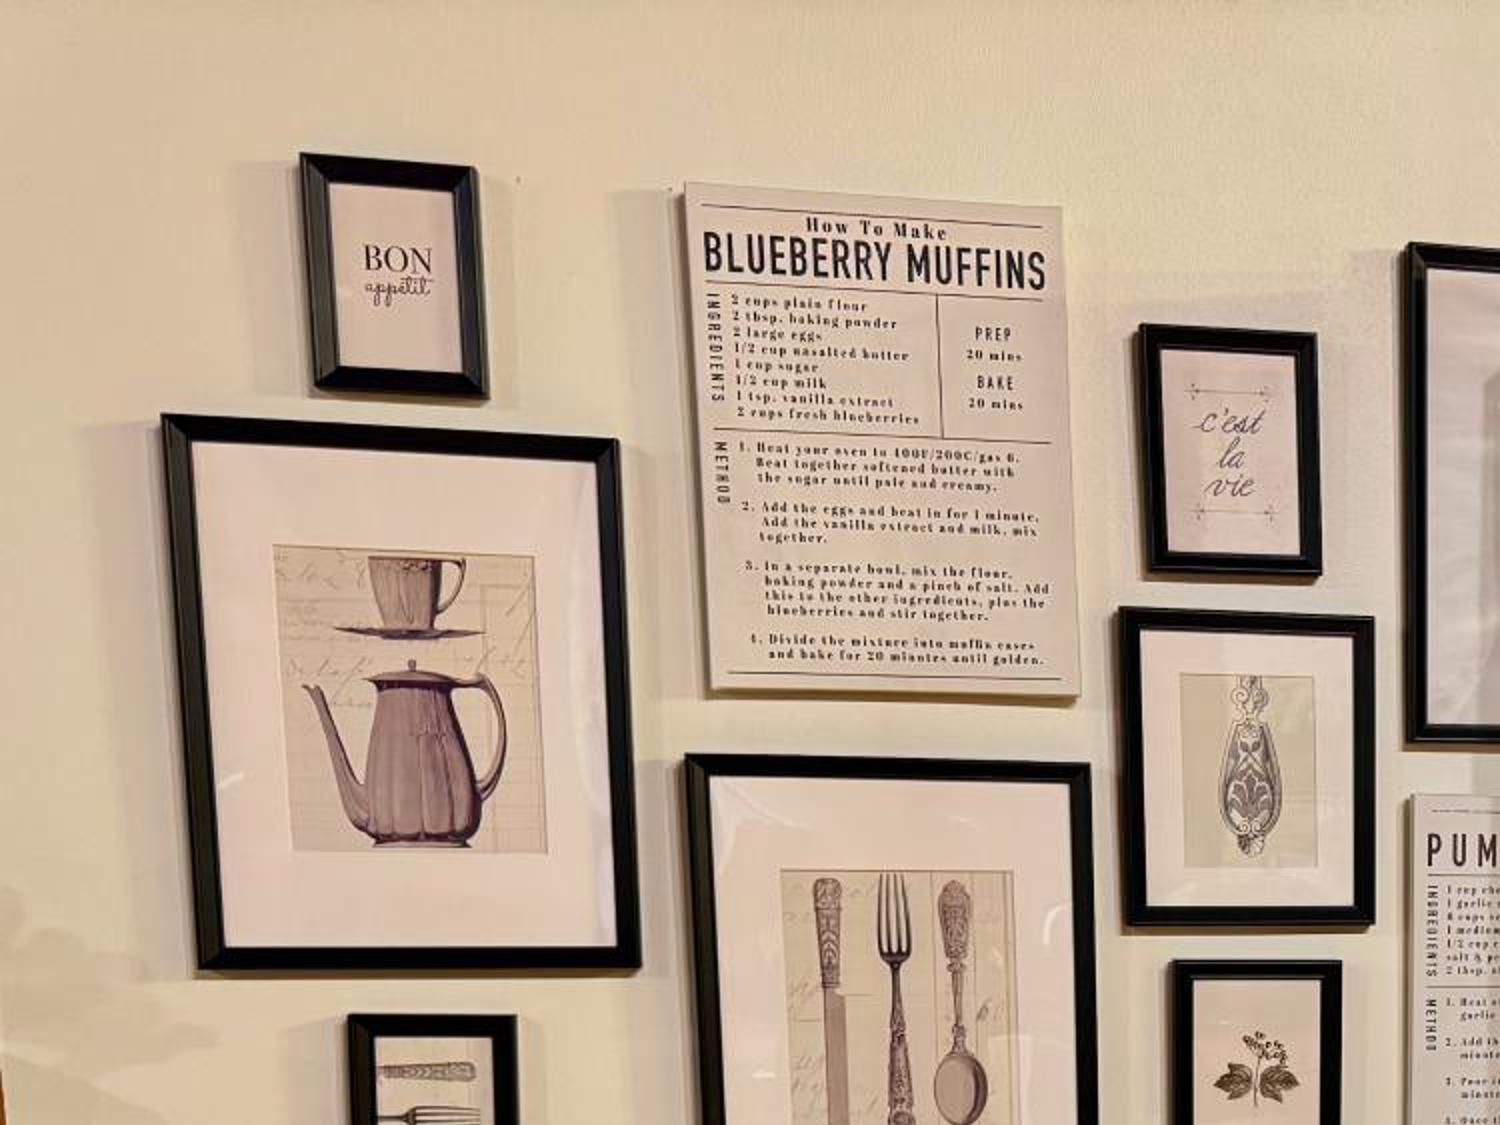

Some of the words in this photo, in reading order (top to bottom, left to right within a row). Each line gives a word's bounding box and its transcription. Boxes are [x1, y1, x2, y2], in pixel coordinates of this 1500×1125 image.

[806, 216, 848, 235] How
[859, 219, 883, 236] To
[894, 221, 947, 241] Make
[363, 243, 432, 274] BON
[704, 231, 891, 282] BLUEBERRY
[907, 243, 1045, 291] MUFFINS
[745, 296, 777, 311] cups
[784, 295, 821, 313] plain
[828, 297, 865, 312] flour
[745, 308, 782, 327] tbsp.
[789, 311, 838, 330] baking
[844, 314, 896, 333] powder
[746, 324, 784, 344] large
[791, 331, 821, 346] eggs
[974, 326, 1012, 342] PREP
[707, 292, 725, 403] INGREDIENTS
[734, 340, 755, 353] 1/2
[761, 345, 787, 358] cup
[862, 346, 908, 361] butter
[966, 349, 985, 362] 20
[989, 350, 1023, 364] mins
[746, 361, 772, 374] cup
[778, 362, 818, 376] sugar
[736, 372, 756, 386] 1/2
[762, 377, 788, 391] cup
[794, 375, 826, 389] milk
[976, 375, 1014, 391] BAKE
[748, 388, 776, 406] tsp.
[783, 390, 833, 405] vanilla
[839, 393, 892, 408] extract
[968, 398, 986, 410] 20
[990, 399, 1024, 412] mins
[751, 408, 782, 422] cups
[789, 406, 827, 420] fresh
[833, 408, 918, 424] blueberries
[1193, 408, 1265, 435] c'est
[756, 439, 789, 453] Heat
[795, 445, 829, 459] your
[834, 446, 867, 456] oven
[872, 444, 887, 457] to
[1216, 436, 1246, 469] la
[714, 440, 731, 504] METHOD
[794, 456, 856, 474] together
[931, 461, 976, 476] butter
[983, 464, 1014, 477] with
[757, 470, 781, 483] the
[787, 475, 827, 488] sugar
[833, 473, 869, 486] until
[875, 474, 904, 491] pale
[911, 476, 936, 489] and
[1204, 474, 1256, 497] vie
[763, 500, 787, 513] Add
[793, 501, 816, 514] the
[823, 506, 853, 519] eggs
[859, 503, 885, 516] and
[890, 504, 921, 517] beat
[927, 506, 941, 518] in
[946, 506, 968, 519] for
[763, 514, 788, 527] Add
[793, 515, 817, 528] the
[823, 516, 874, 530] vanilla
[879, 518, 933, 532] extract
[938, 520, 964, 533] and
[1012, 523, 1036, 536] mix
[759, 528, 826, 547] together.
[764, 559, 778, 571] In
[797, 560, 861, 577] separate
[911, 563, 936, 576] mix
[942, 564, 964, 577] the
[764, 573, 814, 591] baking
[820, 575, 872, 592] powder
[878, 577, 903, 589] and
[922, 578, 961, 595] pinch
[967, 579, 981, 592] of
[986, 580, 1018, 593] salt.
[1025, 581, 1048, 594] Add
[765, 588, 793, 601] this
[799, 589, 813, 601] to
[819, 589, 842, 602] the
[848, 590, 887, 603] other
[988, 594, 1016, 611] plus
[1022, 595, 1044, 608] the
[767, 602, 853, 617] blueberries
[859, 605, 884, 618] and
[890, 606, 917, 618] stir
[922, 607, 988, 624] together.
[769, 632, 815, 645] Divide
[821, 633, 845, 646] the
[850, 634, 908, 647] mixture
[913, 636, 943, 648] into
[997, 642, 1034, 650] cases
[768, 646, 794, 659] and
[799, 647, 833, 660] bake
[839, 648, 860, 660] for
[866, 649, 884, 661] 20
[889, 649, 946, 662] minutes
[952, 651, 987, 663] until
[993, 651, 1043, 668] golden.
